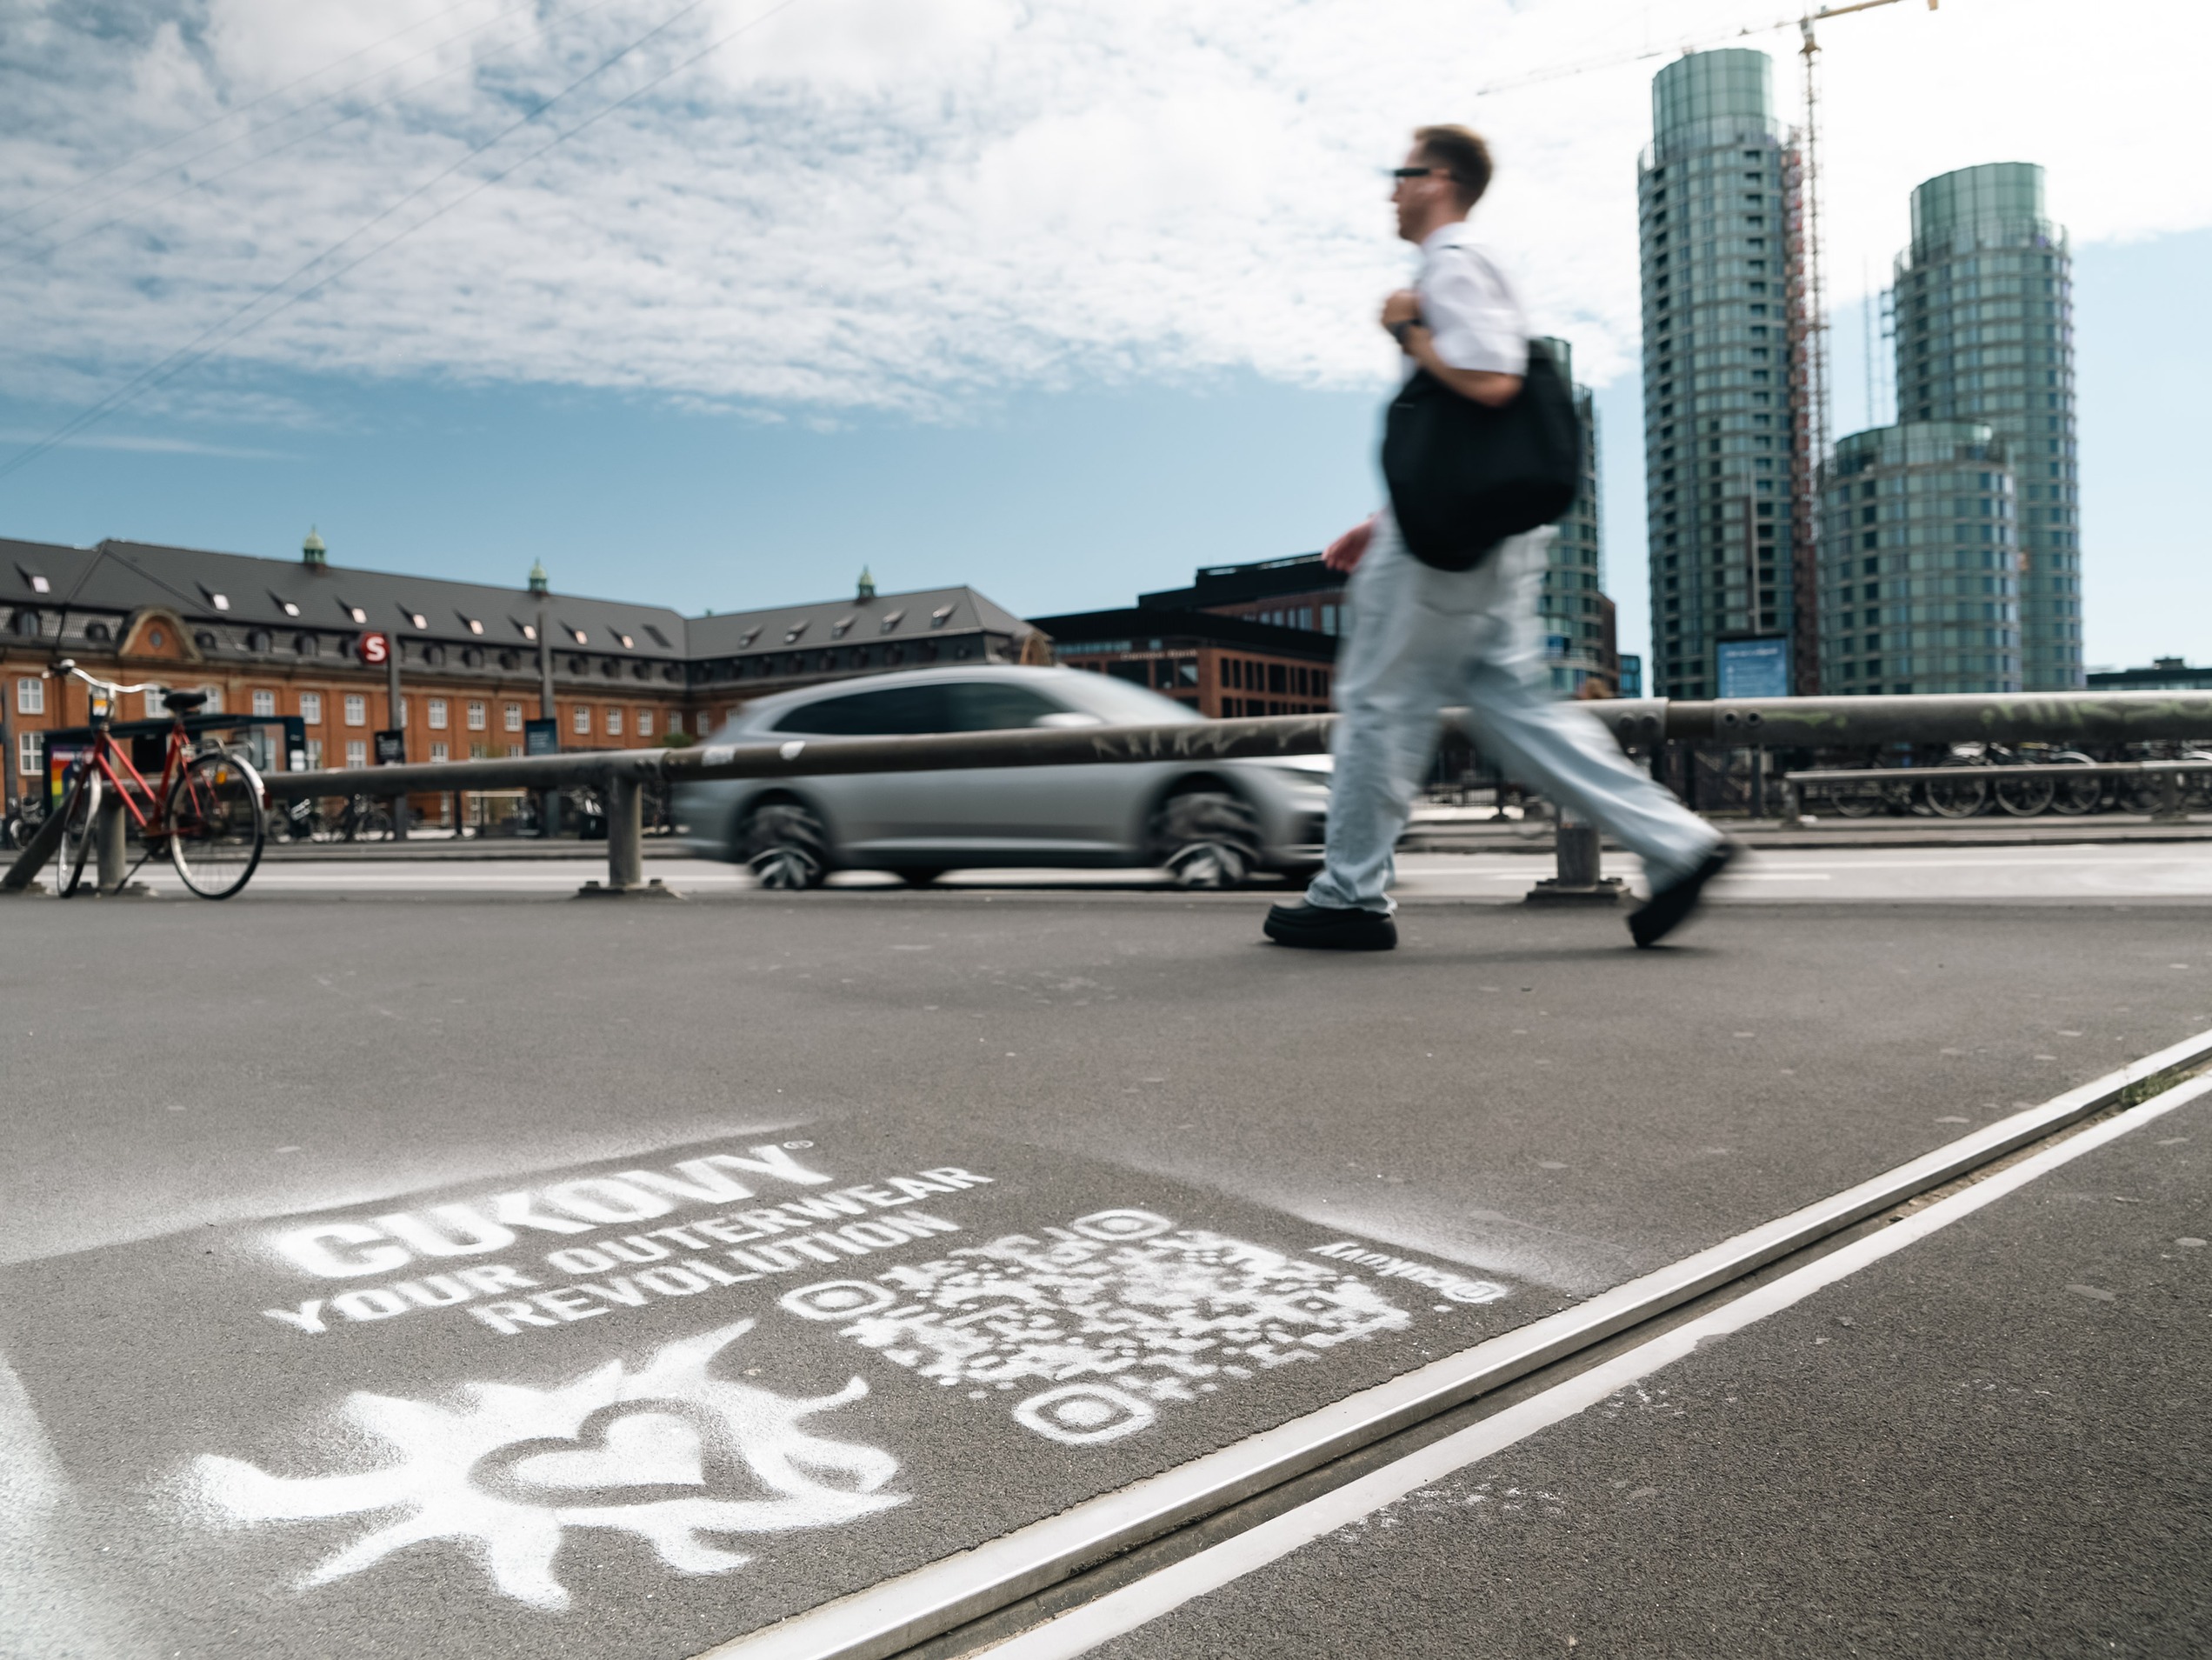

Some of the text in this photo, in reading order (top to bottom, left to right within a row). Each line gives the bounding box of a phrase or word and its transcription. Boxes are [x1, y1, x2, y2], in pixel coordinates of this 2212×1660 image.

[366, 636, 386, 662] S
[264, 1167, 995, 1335] YOUR OUTERWEAR
[468, 1210, 960, 1335] REVOLUTION
